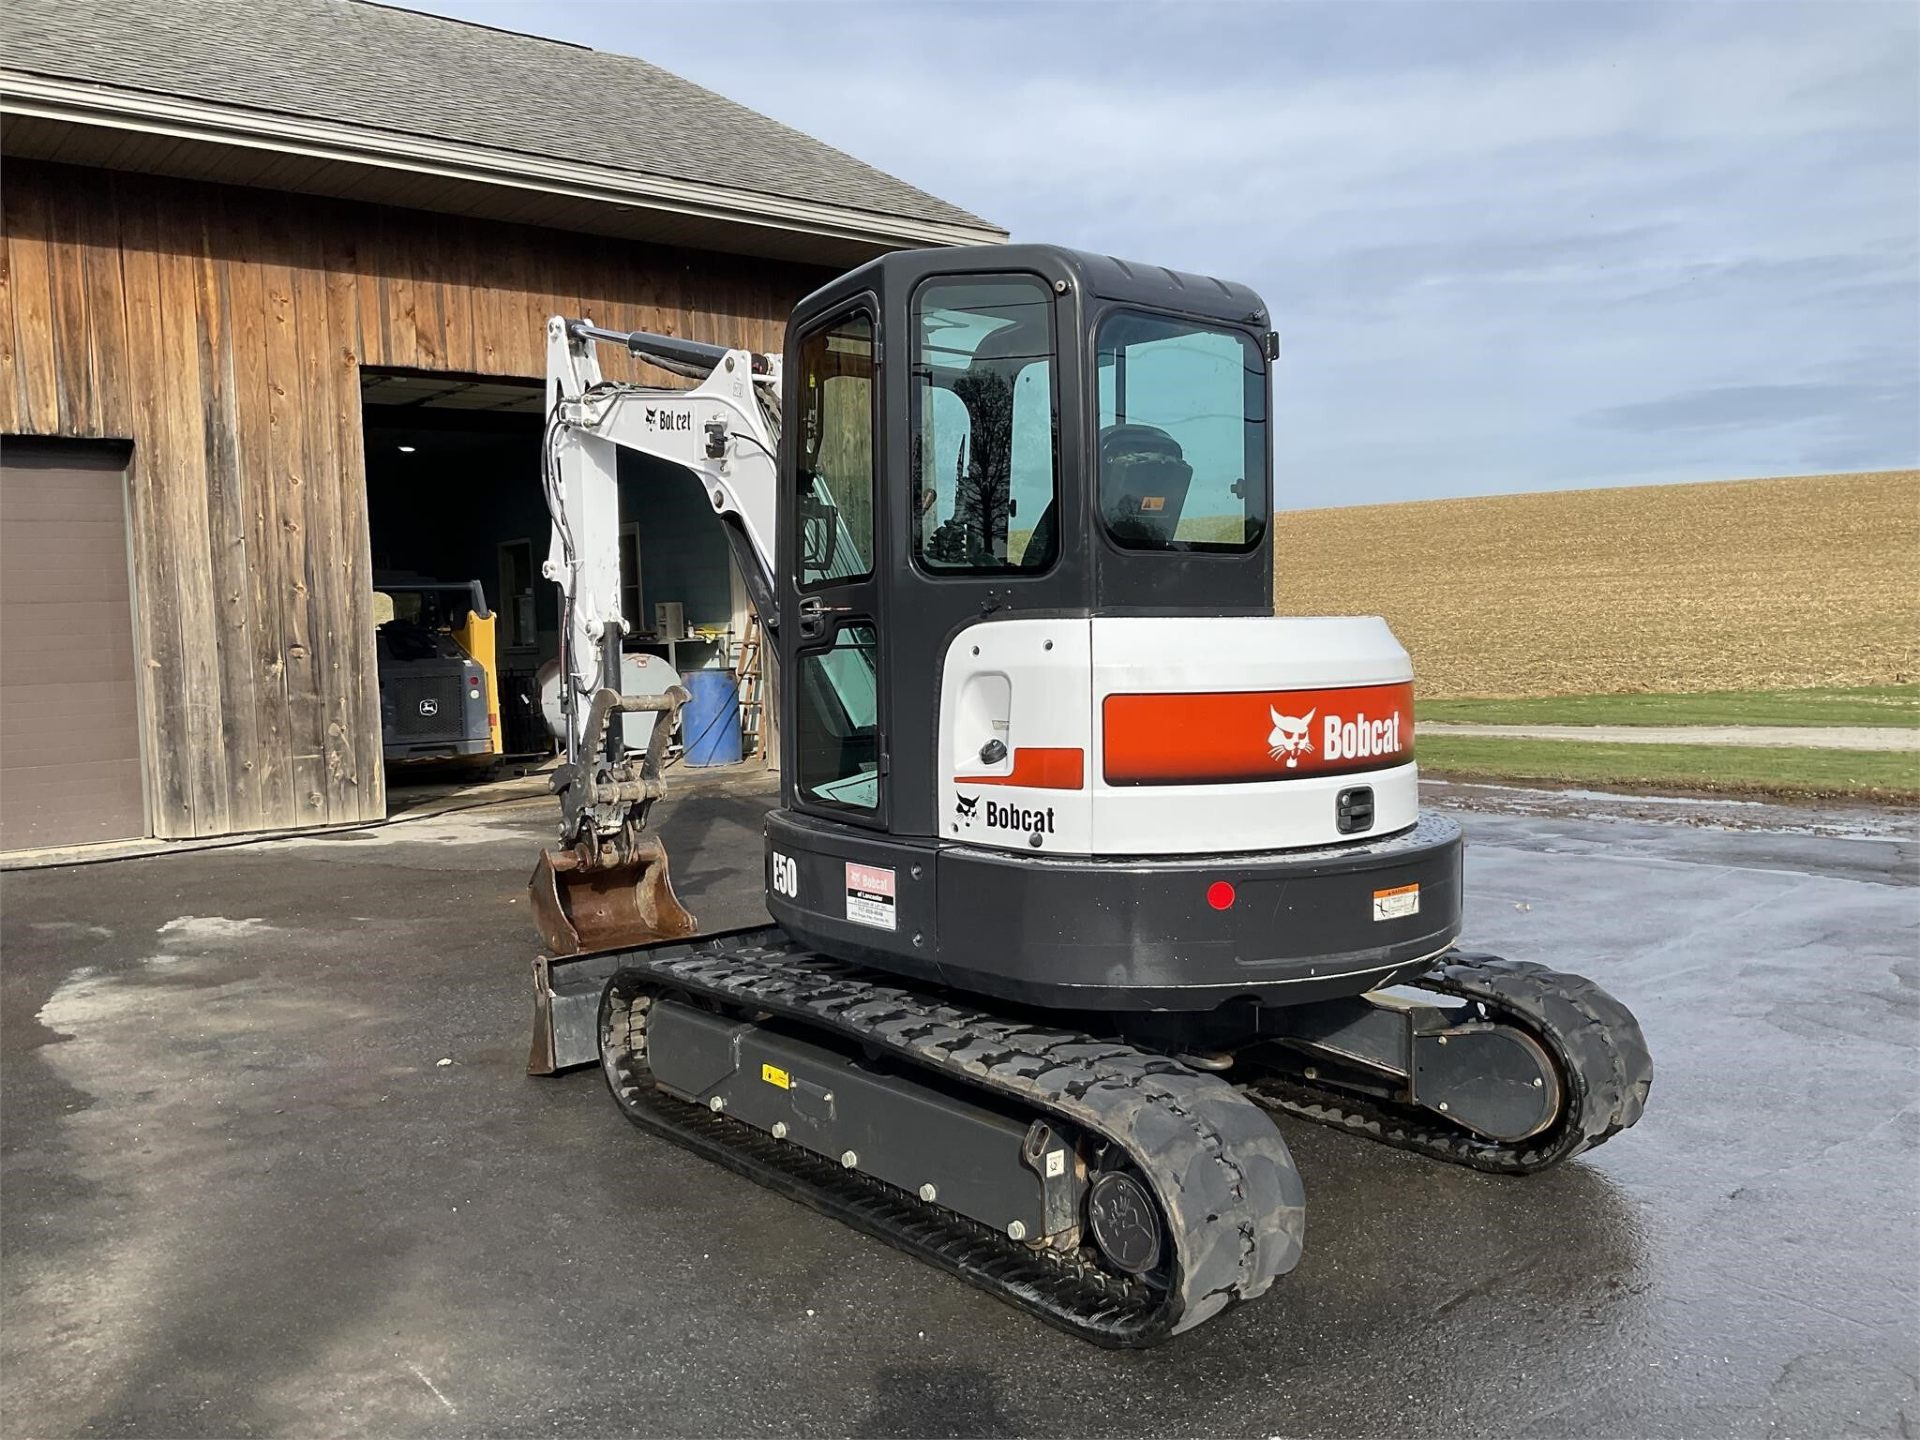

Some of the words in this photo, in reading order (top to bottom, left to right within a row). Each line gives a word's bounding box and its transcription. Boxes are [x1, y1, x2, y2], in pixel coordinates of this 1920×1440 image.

[1324, 711, 1399, 760] Bobcat
[986, 801, 1055, 834] Bobcat
[772, 851, 798, 898] E50
